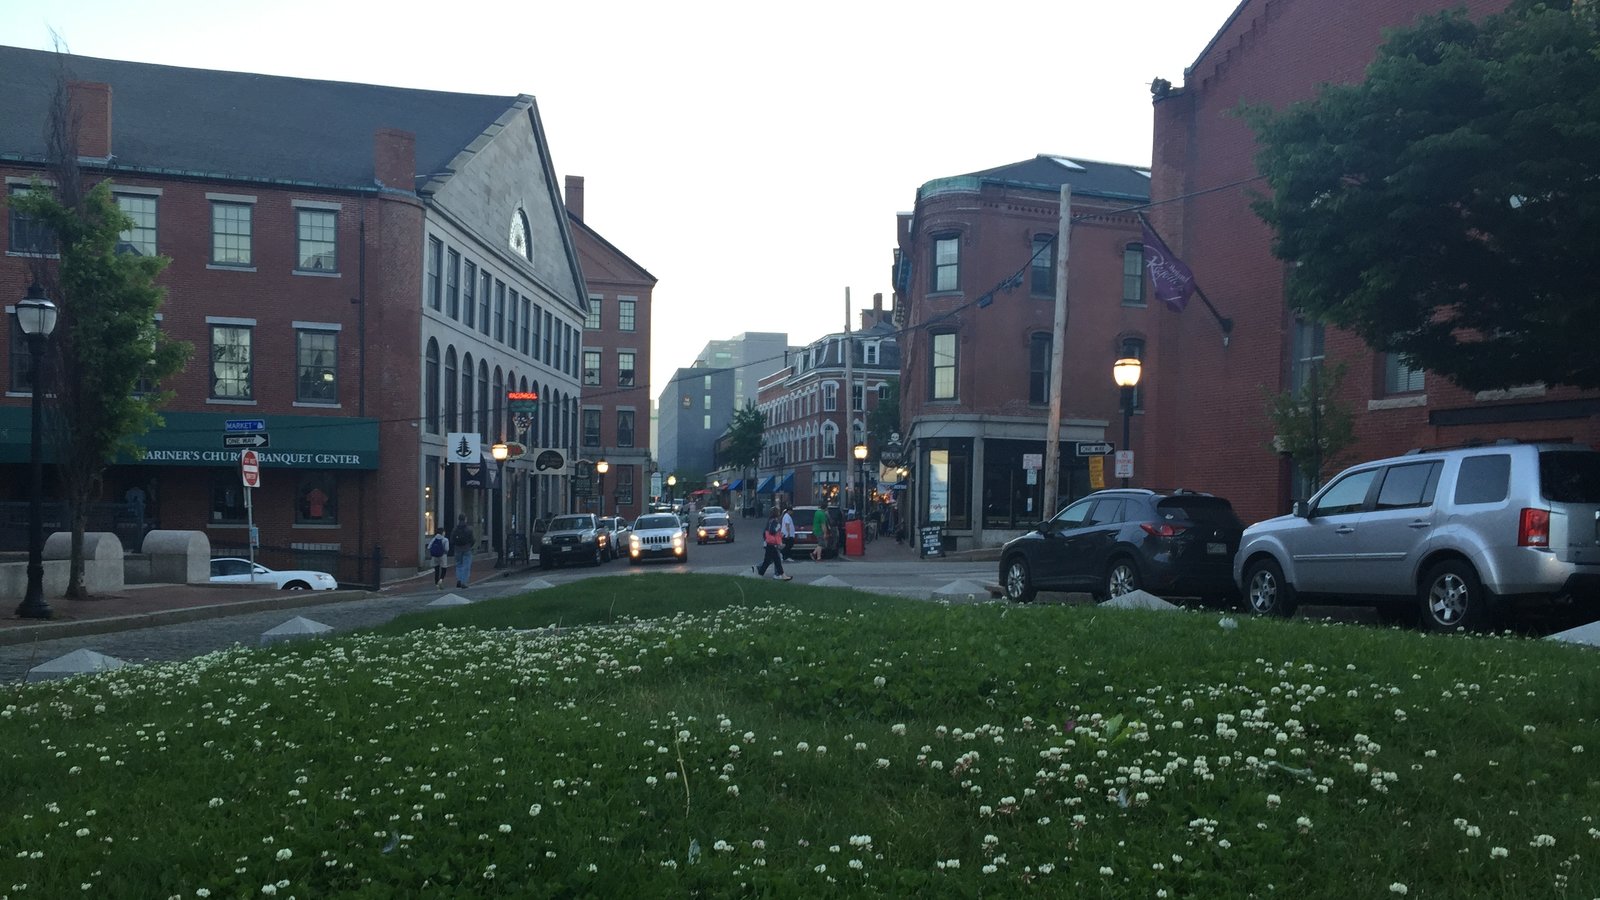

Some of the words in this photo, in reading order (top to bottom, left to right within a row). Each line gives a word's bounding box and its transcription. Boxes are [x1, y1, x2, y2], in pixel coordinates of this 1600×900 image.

[242, 437, 255, 445] WAY
[202, 451, 241, 462] CHUR
[258, 452, 313, 465] BANQUET
[315, 454, 360, 465] CENTER
